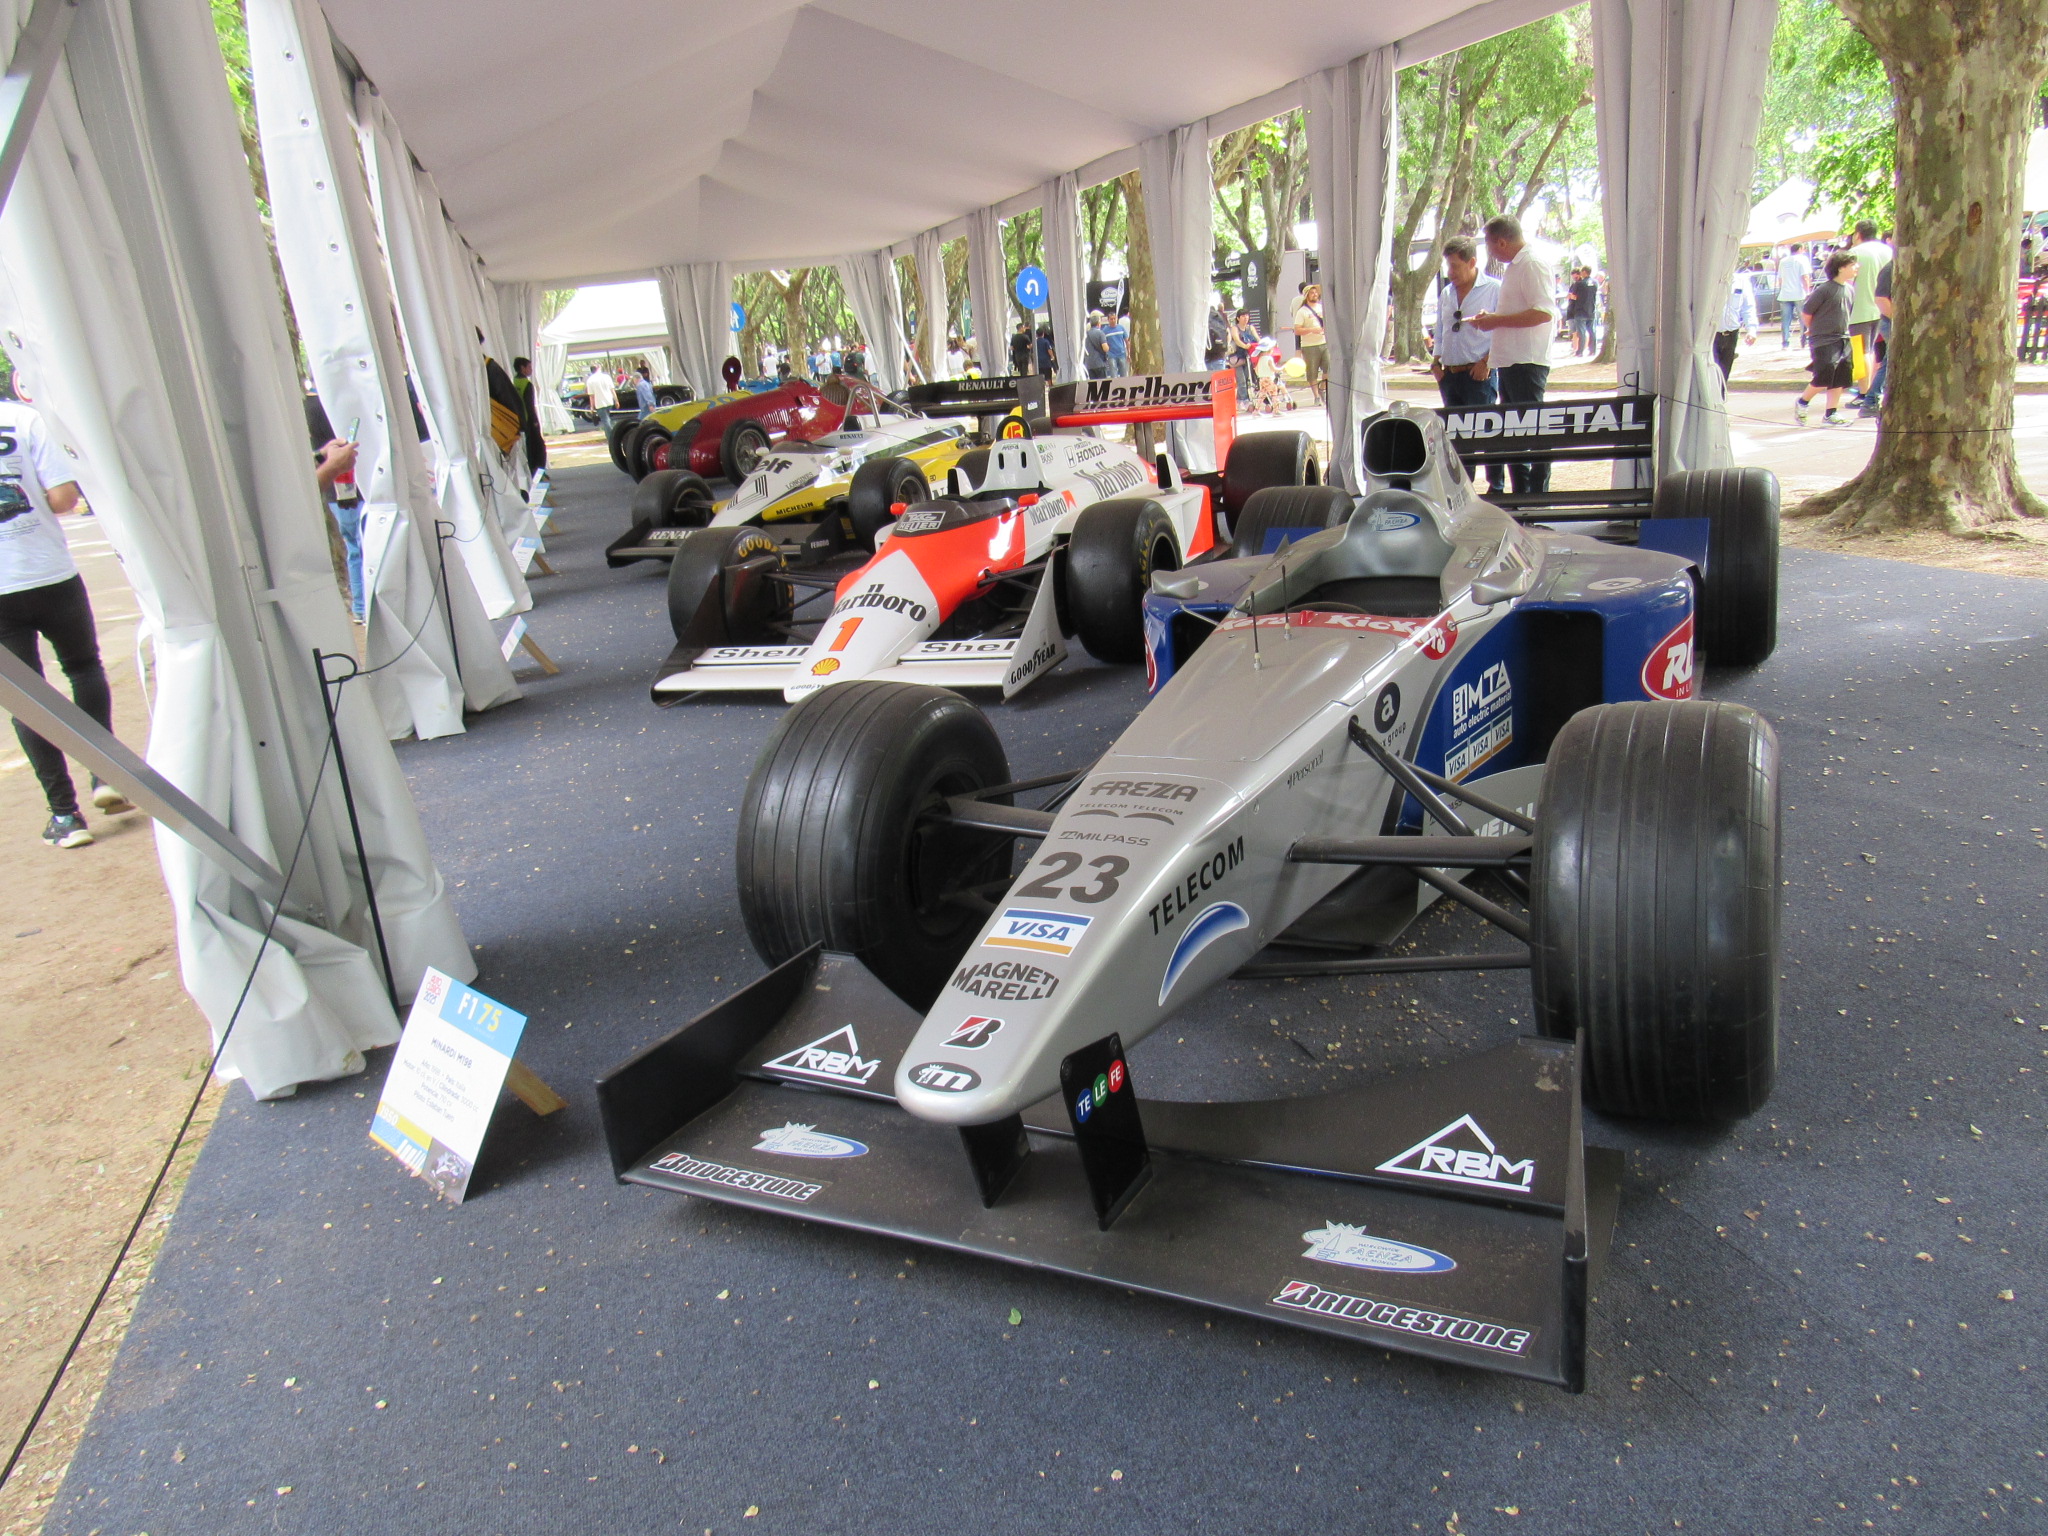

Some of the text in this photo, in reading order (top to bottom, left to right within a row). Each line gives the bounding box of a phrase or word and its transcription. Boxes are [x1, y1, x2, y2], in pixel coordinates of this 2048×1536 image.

[958, 380, 1005, 392] RENAULT
[1446, 402, 1647, 439] NDMETAL
[755, 457, 793, 474] elf
[1076, 443, 1107, 463] HONDA
[785, 471, 814, 490] LONGINES
[1073, 460, 1144, 501] Marlboro
[776, 501, 814, 516] MICHELIN
[905, 512, 938, 522] TAG
[1028, 497, 1067, 526] Marlboro
[648, 530, 697, 540] RENA
[898, 521, 939, 533] HEUER
[828, 617, 864, 651] 1
[921, 640, 1016, 653] Shel
[713, 646, 810, 658] Shell
[1010, 643, 1056, 685] GOODYEAR
[1676, 687, 1685, 698] IN
[1453, 689, 1512, 739] auto electric material
[1388, 721, 1407, 747] group
[1449, 719, 1510, 776] VISA VISA VISA
[1133, 804, 1184, 816] TELECOM
[1014, 851, 1130, 904] 23
[1149, 836, 1245, 936] TELECOM
[1007, 920, 1071, 942] VISA
[457, 991, 479, 1021] F1
[476, 1001, 504, 1034] 75
[430, 1036, 473, 1069] MINARDI M198
[794, 1047, 882, 1080] RBM
[649, 1152, 823, 1201] BRIDGESTONE
[1420, 1145, 1535, 1187] RBM
[1345, 1247, 1413, 1264] FAENZA
[1272, 1280, 1530, 1353] BRIDGESTONE
